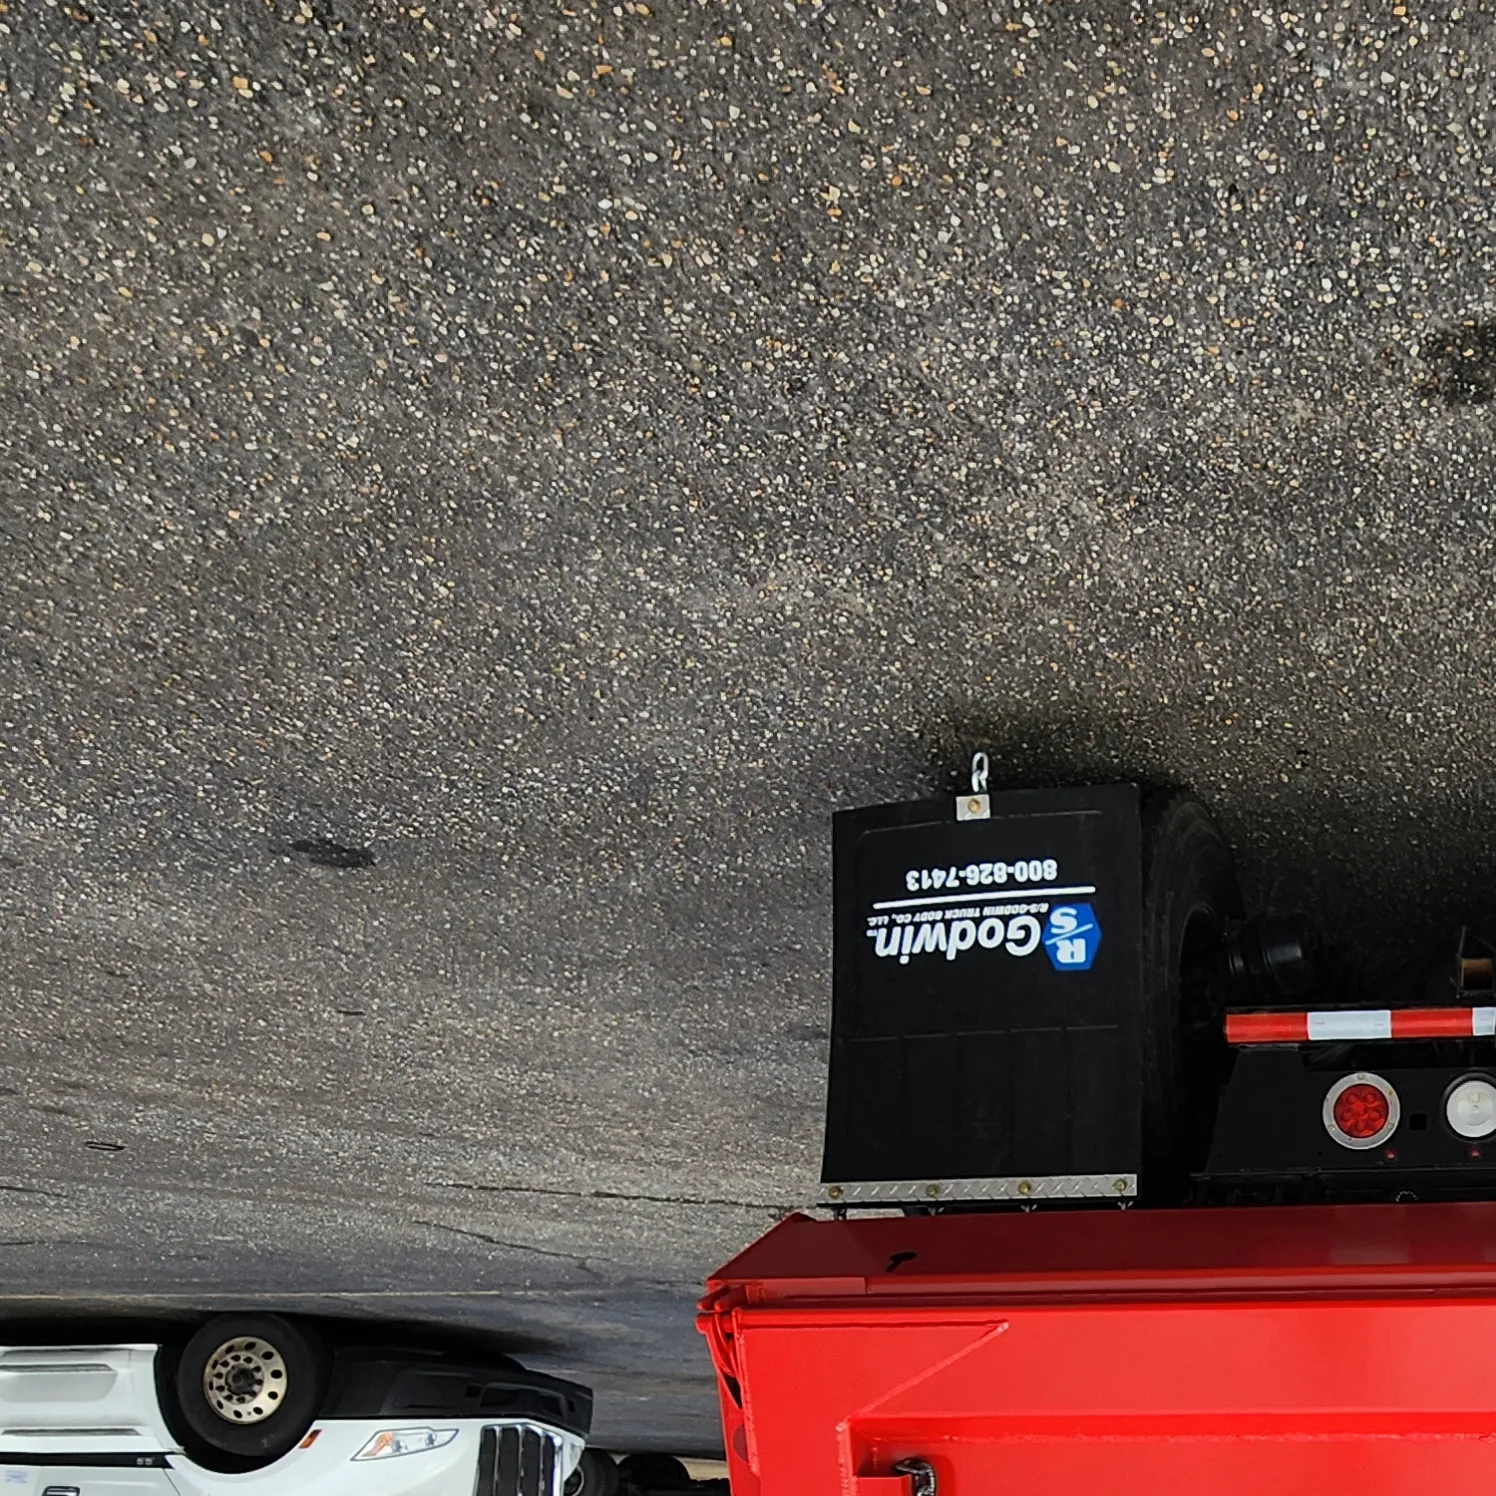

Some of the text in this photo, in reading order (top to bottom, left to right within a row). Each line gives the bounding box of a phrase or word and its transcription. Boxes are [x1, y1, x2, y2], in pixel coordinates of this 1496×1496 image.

[906, 859, 1057, 891] 800-826-7413
[913, 910, 942, 921] BODY
[945, 907, 980, 919] TRUCK
[874, 916, 1041, 964] Godwin
